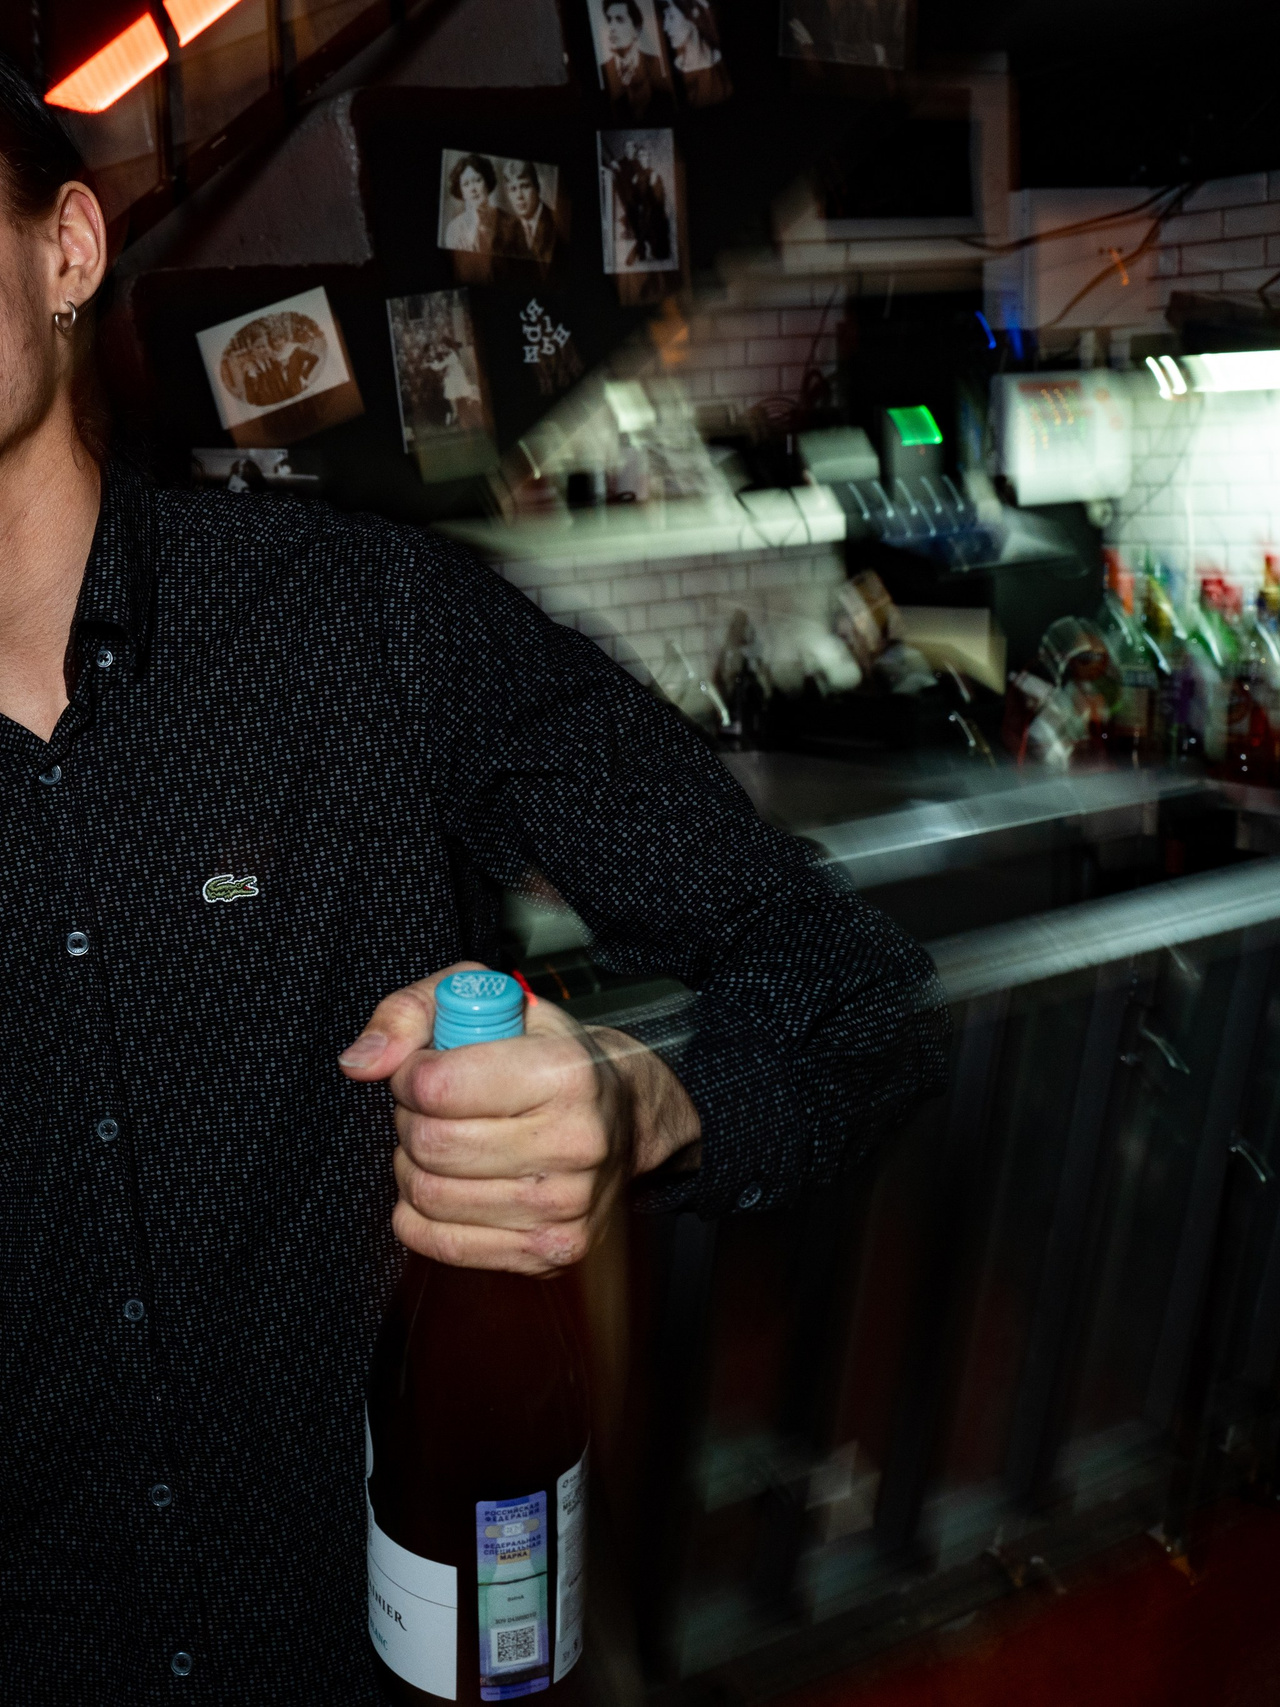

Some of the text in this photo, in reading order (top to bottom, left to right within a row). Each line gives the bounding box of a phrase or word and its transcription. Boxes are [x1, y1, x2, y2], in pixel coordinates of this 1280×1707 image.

[485, 1502, 540, 1516] РОССИЙСКАЯ
[484, 1534, 541, 1549] ФЕДЕРАЛЬНАЯ
[500, 1551, 527, 1560] МАРКА
